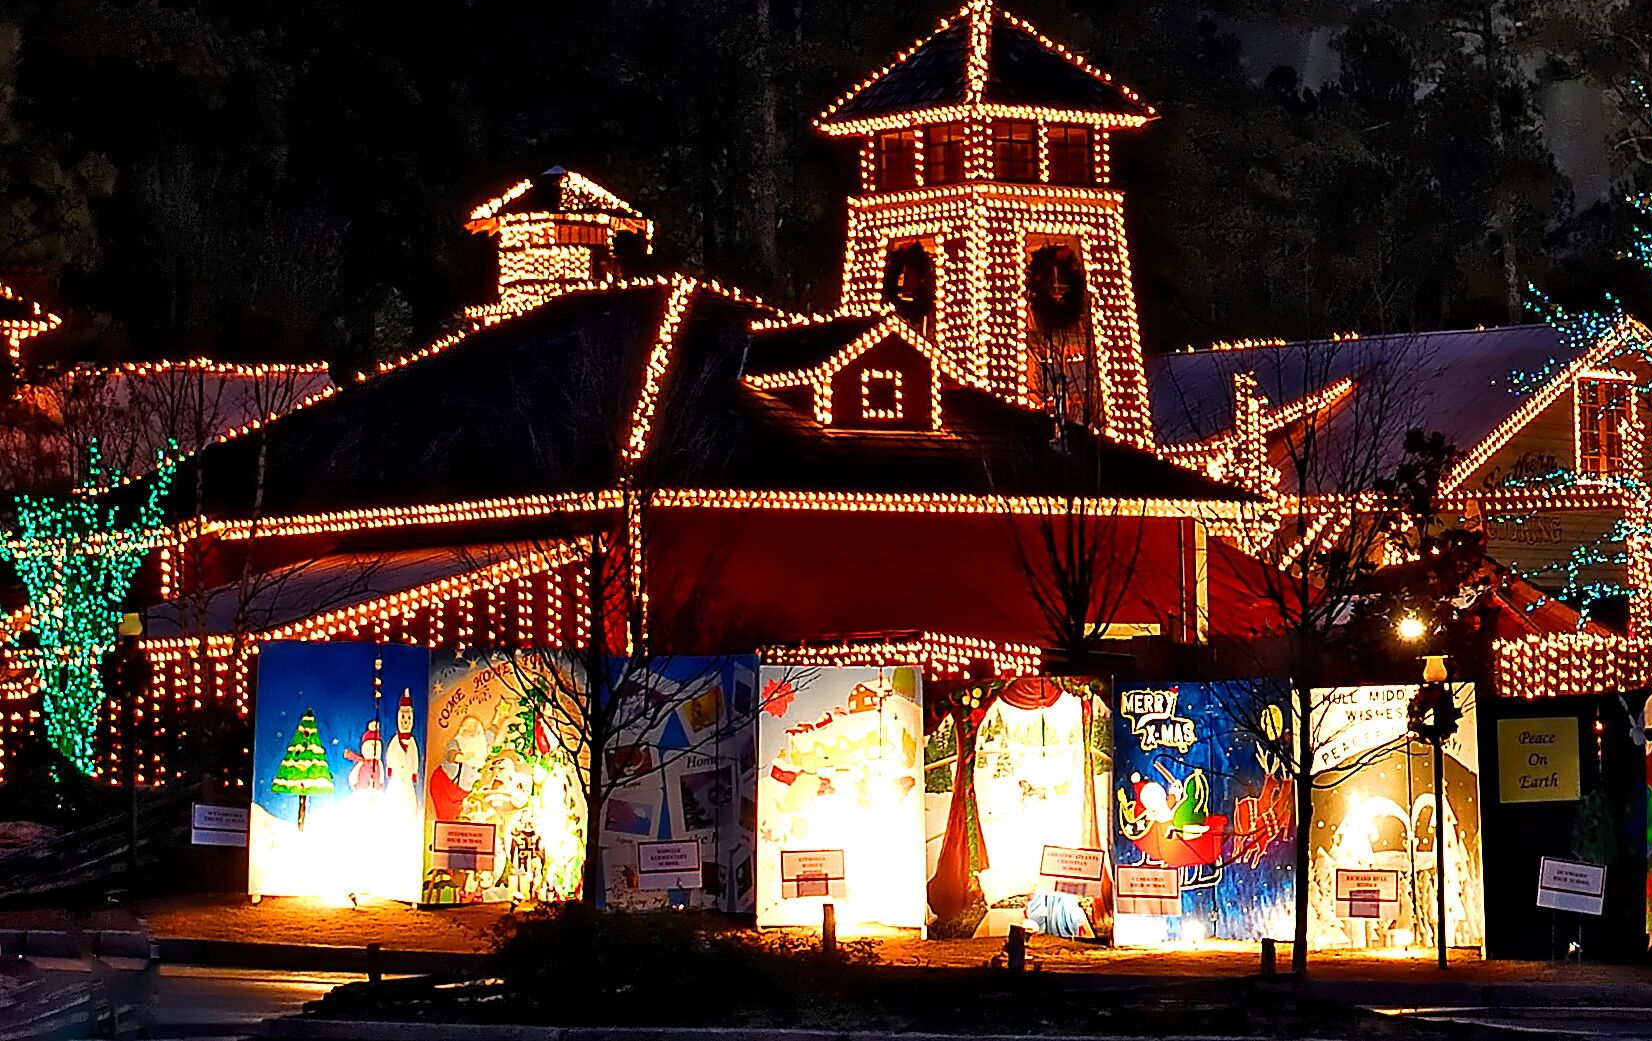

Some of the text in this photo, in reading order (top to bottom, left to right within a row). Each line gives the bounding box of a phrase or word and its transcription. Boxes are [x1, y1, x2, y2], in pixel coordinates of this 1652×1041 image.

[438, 687, 466, 729] COME
[1121, 691, 1176, 724] MERRY
[1145, 722, 1196, 745] X-MAS
[1518, 731, 1557, 745] Peace
[1527, 752, 1549, 766] On
[1518, 771, 1559, 789] Earth
